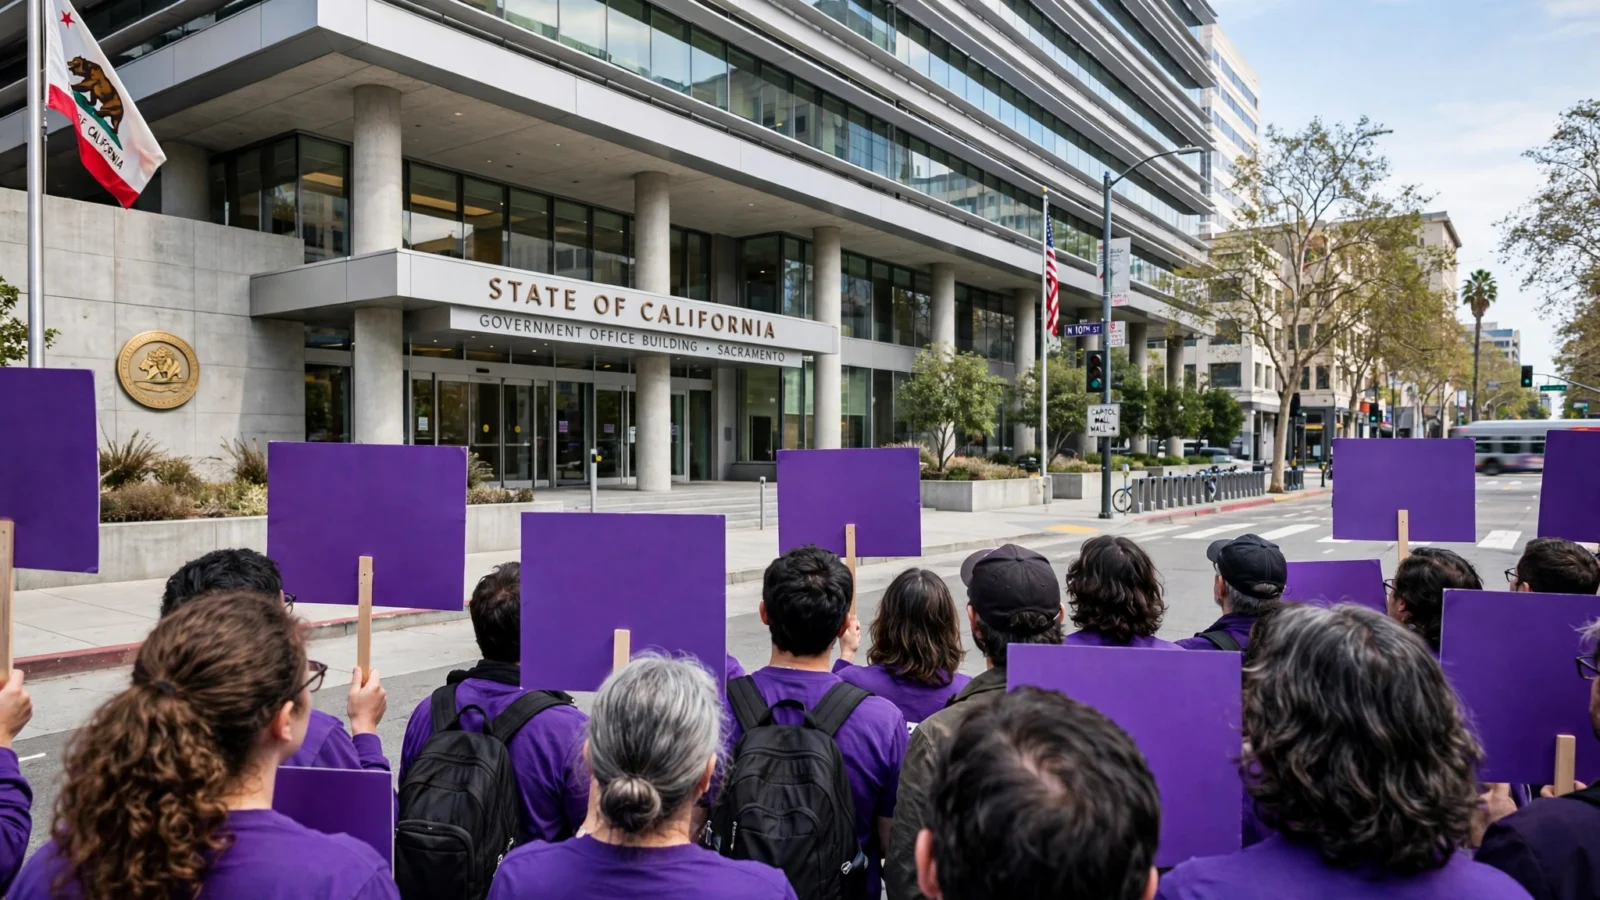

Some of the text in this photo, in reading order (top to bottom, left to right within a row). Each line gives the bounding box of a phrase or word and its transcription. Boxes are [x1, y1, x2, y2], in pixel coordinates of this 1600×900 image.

[489, 277, 775, 339] STATE OF CALIFORNIA
[1067, 327, 1073, 335] N
[479, 314, 785, 362] GOVERNMENT OFFICE BUILDING SACRAMENTO
